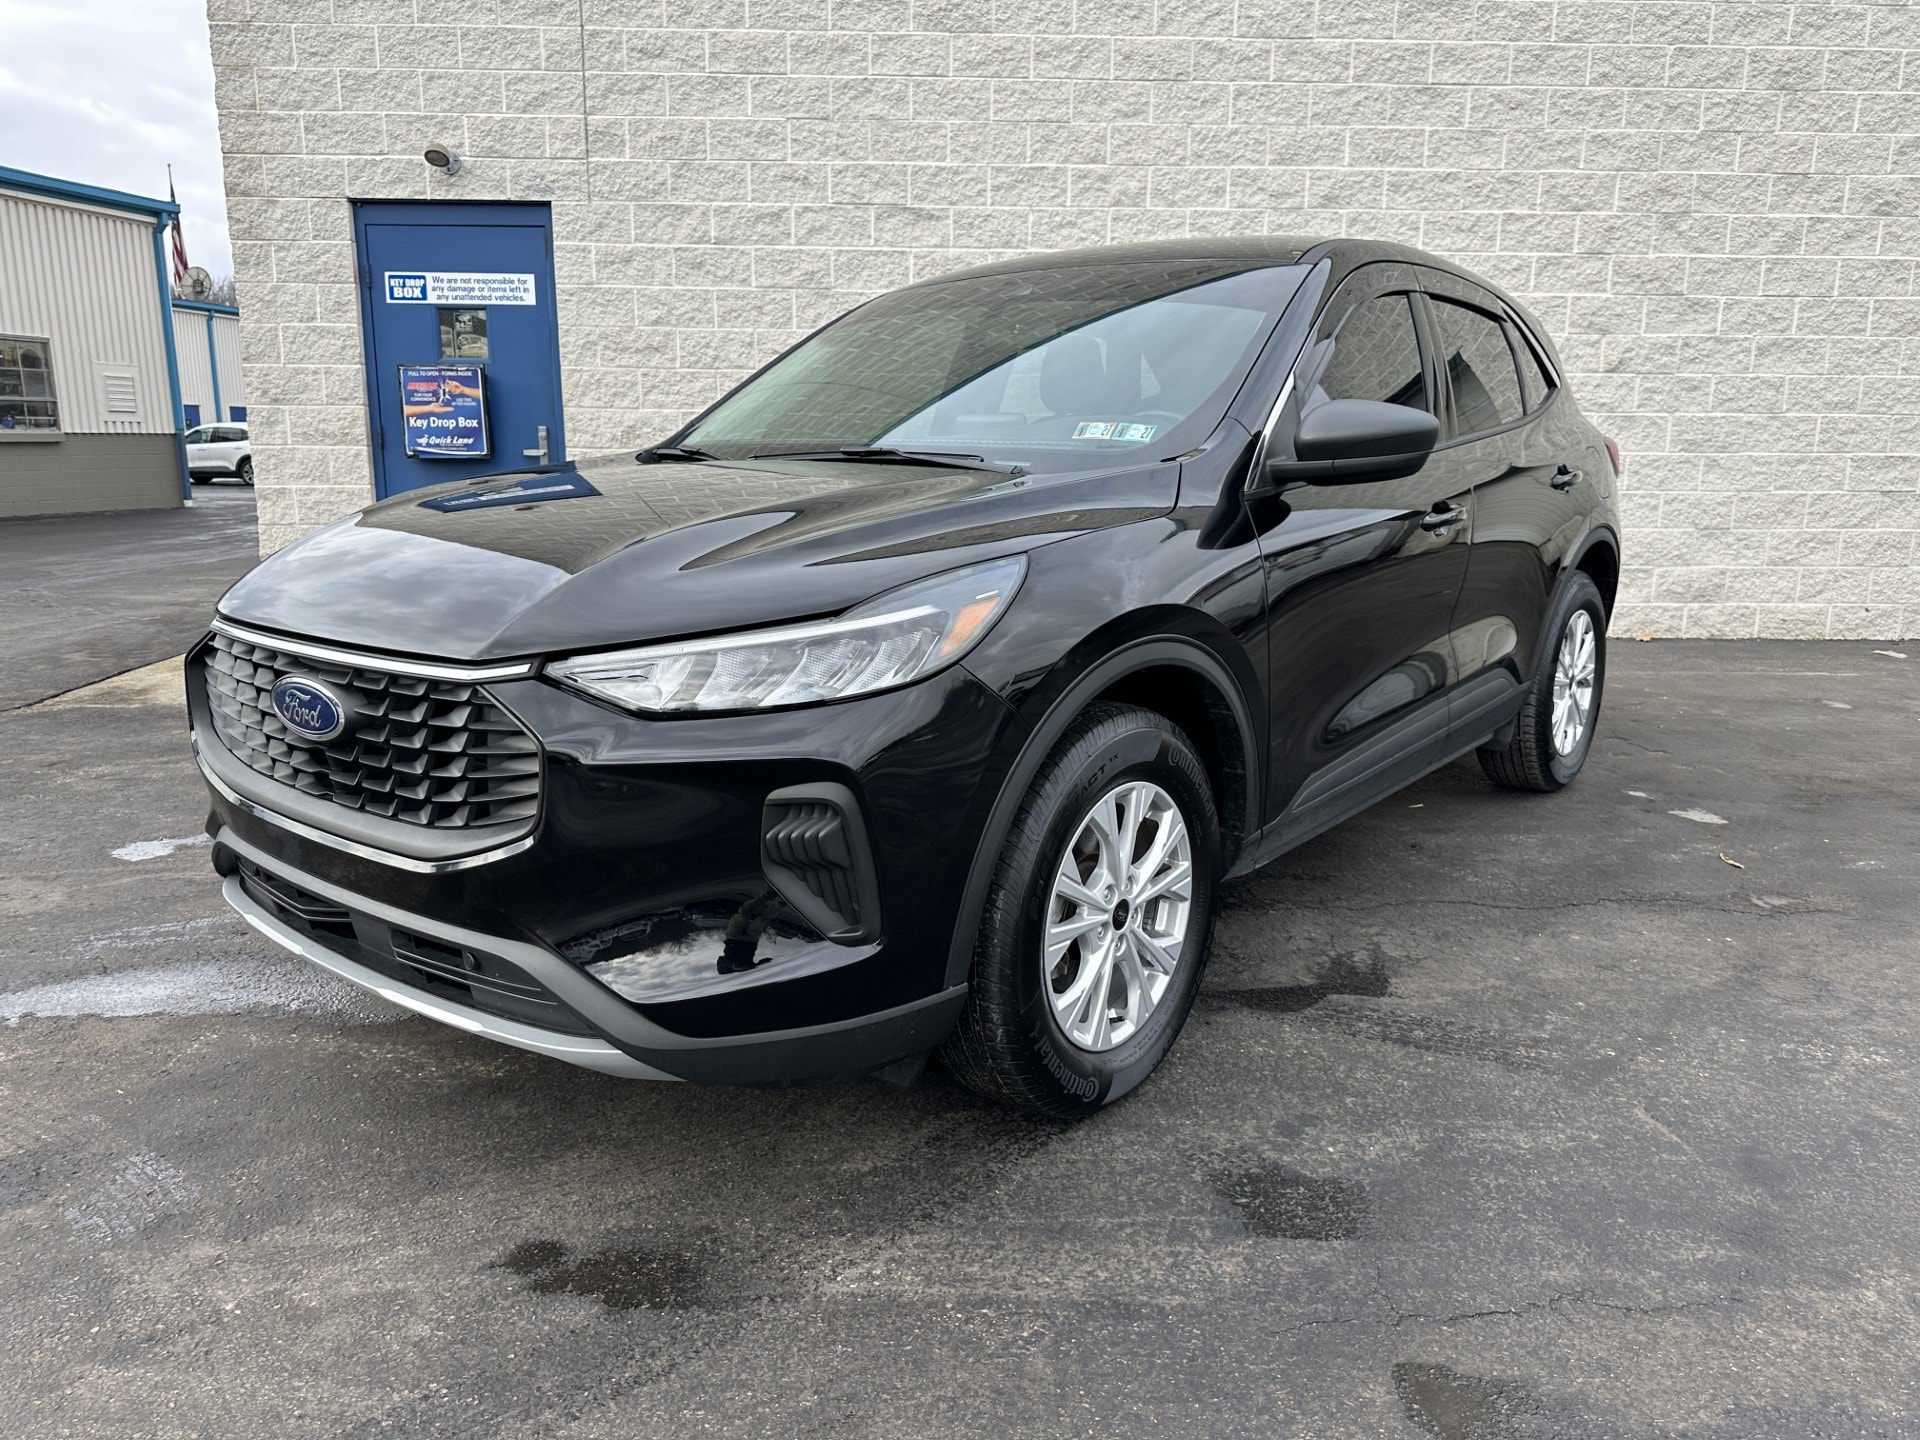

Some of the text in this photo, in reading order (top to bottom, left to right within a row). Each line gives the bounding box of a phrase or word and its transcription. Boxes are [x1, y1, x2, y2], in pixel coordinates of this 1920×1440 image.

[390, 278, 425, 287] KEY DROP
[432, 276, 444, 284] We
[473, 277, 515, 287] responsible
[393, 287, 423, 298] BOX
[447, 285, 476, 294] damage
[487, 285, 507, 293] items
[509, 285, 521, 293] left
[451, 293, 492, 301] unattended
[494, 294, 526, 302] vehicles.
[409, 416, 479, 430] Key Drop Box
[1140, 426, 1153, 439] 27
[428, 435, 452, 445] Quick
[452, 436, 474, 445] Lane
[283, 688, 322, 728] Ford
[1033, 1034, 1100, 1103] Continental
